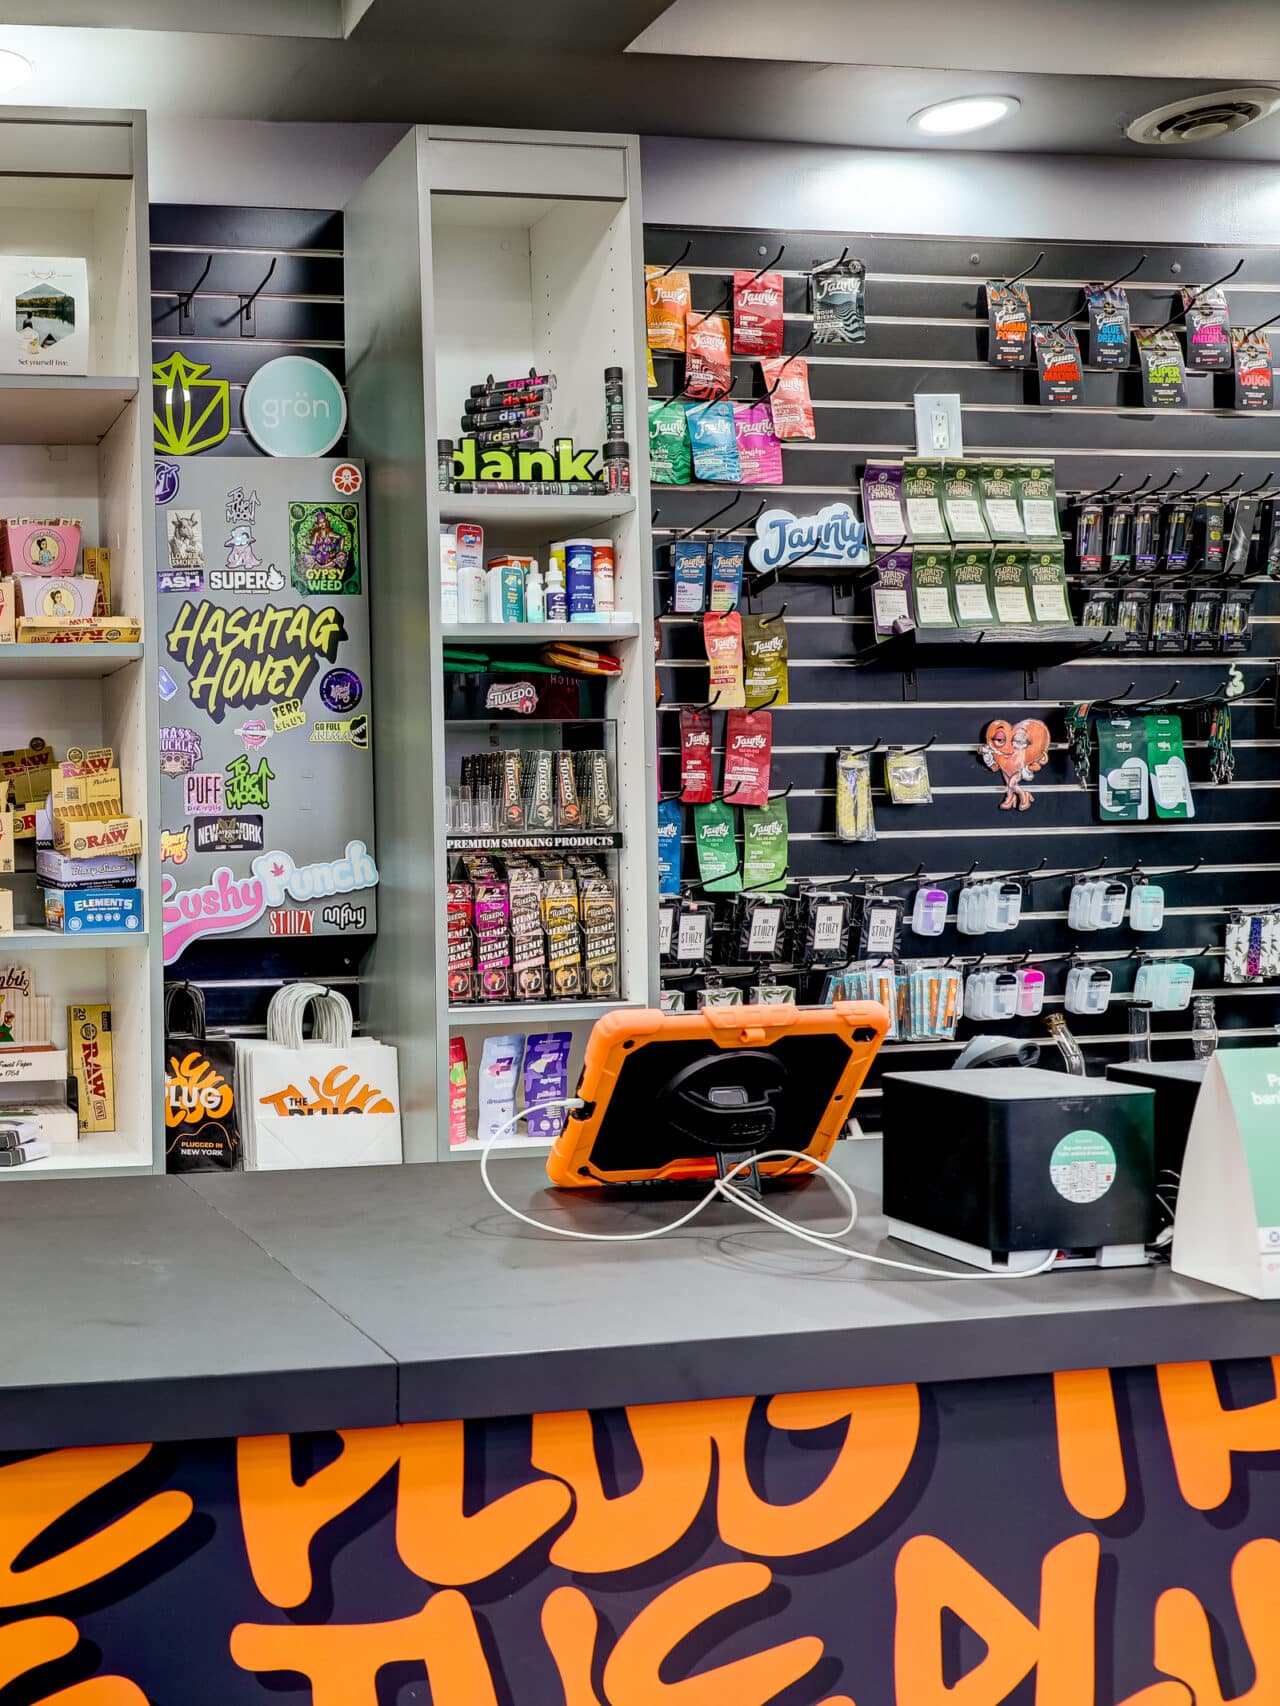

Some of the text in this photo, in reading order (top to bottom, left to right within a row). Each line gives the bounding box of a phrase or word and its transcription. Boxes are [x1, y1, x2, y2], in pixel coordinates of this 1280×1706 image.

[738, 288, 778, 306] Jaunty
[1102, 325, 1120, 334] BLUE
[1098, 334, 1124, 343] DREAM
[18, 358, 28, 366] Set
[29, 358, 54, 368] yourself
[1241, 375, 1270, 387] COUGH
[261, 392, 329, 428] grön
[493, 428, 529, 442] dank
[453, 438, 598, 481] dank
[764, 511, 867, 565] Jaunty
[306, 569, 345, 581] GYPSY
[956, 567, 984, 576] FLORIST
[958, 574, 982, 583] FARMS
[160, 576, 199, 587] ASH
[210, 572, 266, 589] SUPER
[308, 580, 343, 591] WEED
[168, 601, 340, 666] HASHTAG
[189, 649, 312, 714] HONEY
[490, 687, 533, 705] TUXEDO
[272, 701, 300, 718] TERP
[315, 723, 324, 731] GO
[326, 723, 341, 731] FULL
[227, 754, 248, 773] TO
[539, 759, 549, 800] TUXEDO
[561, 759, 573, 800] TUXEDO
[594, 759, 606, 800] TUXEDO
[187, 776, 221, 804] PUFF
[86, 829, 128, 849] RAW
[198, 824, 262, 846] NEW YORK
[447, 836, 614, 849] PREMIUM SMOKING PRODUCTS
[261, 843, 374, 906] Punch
[74, 898, 133, 911] ELEMENTS
[270, 910, 315, 934] STIIIZY
[480, 941, 508, 954] HEMP
[515, 939, 543, 953] HEMP
[551, 937, 578, 951] HEMP
[588, 937, 615, 950] HEMP
[480, 949, 509, 962] WRAPS
[515, 948, 544, 962] WRAPS
[551, 946, 579, 959] WRAPS
[588, 946, 615, 959] WRAPS
[484, 960, 504, 969] BERRY
[77, 1008, 86, 1021] 20
[81, 1041, 106, 1099] RAW
[165, 1086, 220, 1108] LUG
[289, 1097, 307, 1106] THE
[235, 1383, 921, 1607] PLUG
